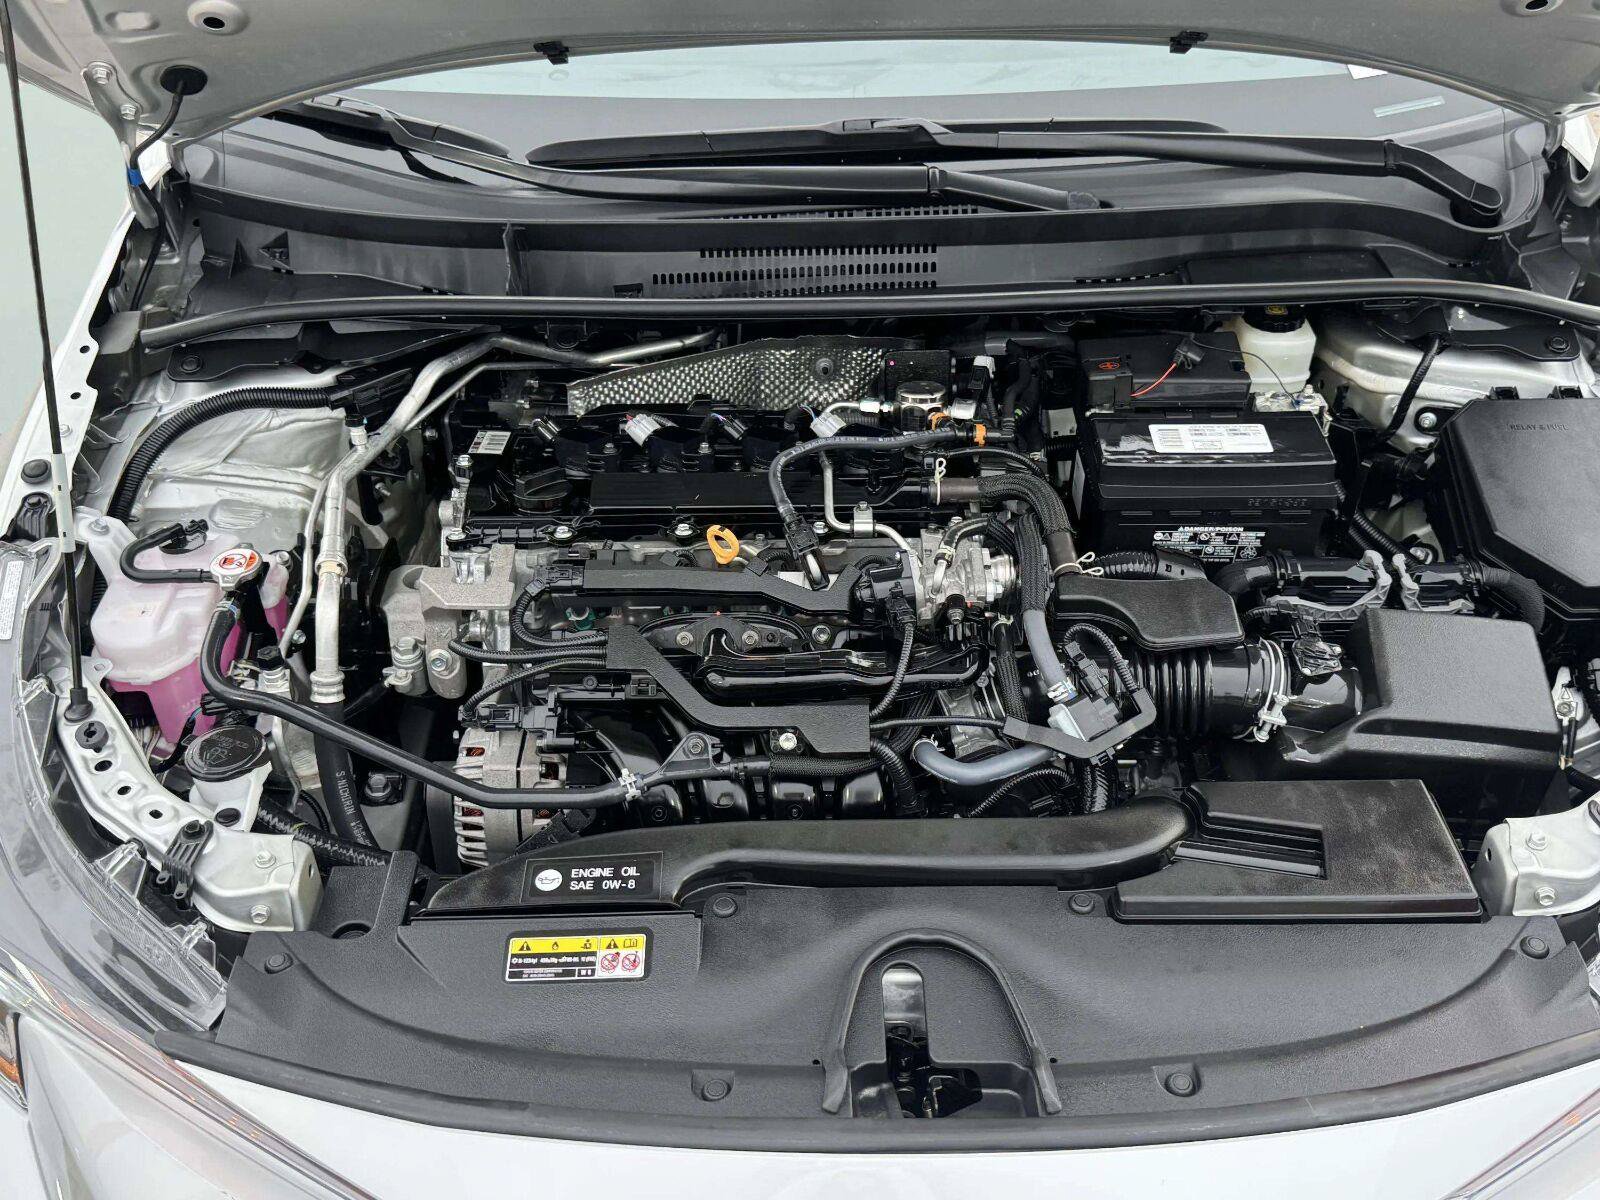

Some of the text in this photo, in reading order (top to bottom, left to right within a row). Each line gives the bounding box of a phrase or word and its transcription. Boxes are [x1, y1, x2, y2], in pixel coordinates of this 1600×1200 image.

[571, 866, 640, 878] ENGINE OIL
[569, 879, 636, 891] SAE 0W-8
